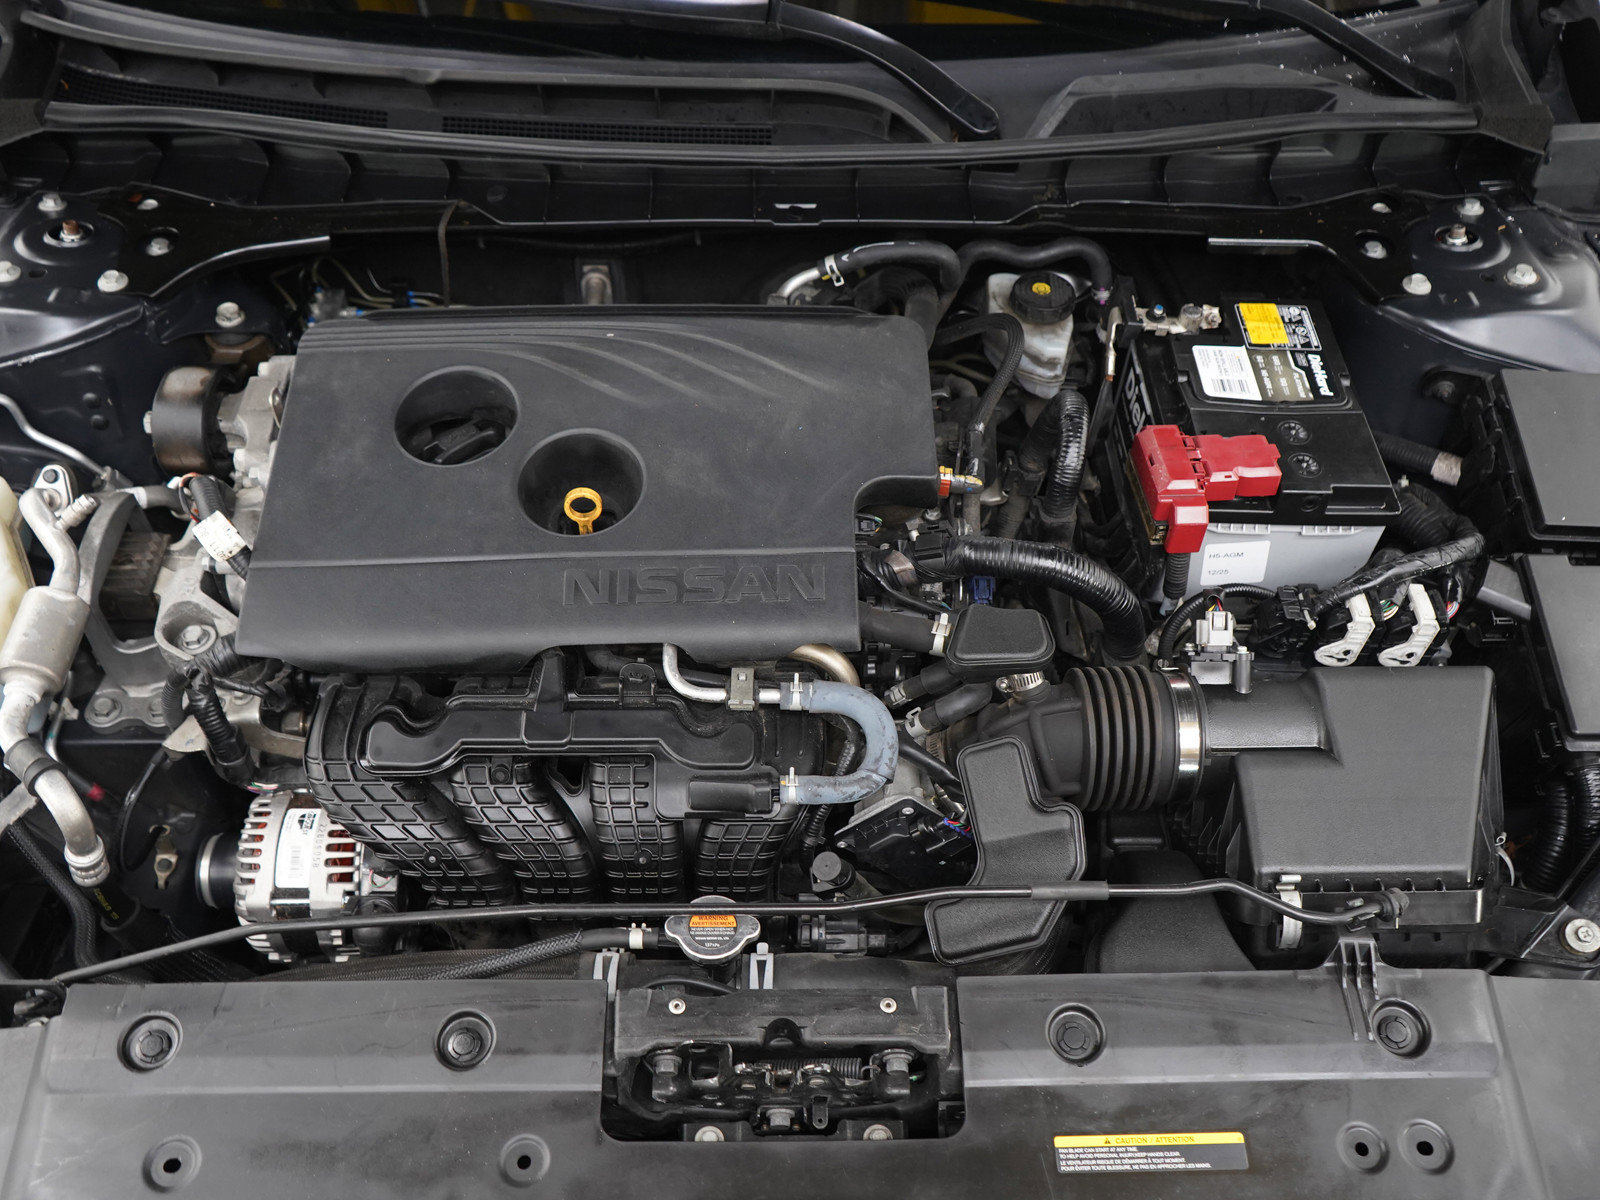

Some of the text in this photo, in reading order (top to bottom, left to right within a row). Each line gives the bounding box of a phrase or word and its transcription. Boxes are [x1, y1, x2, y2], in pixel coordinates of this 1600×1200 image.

[1307, 353, 1334, 396] DieHard
[1293, 371, 1307, 398] PLATINUM
[1208, 551, 1244, 560] H5-AGM
[1207, 569, 1230, 577] 12/25
[562, 564, 826, 606] NISSAN
[1115, 1136, 1148, 1145] CAUTION
[1156, 1135, 1195, 1144] ATTENTION
